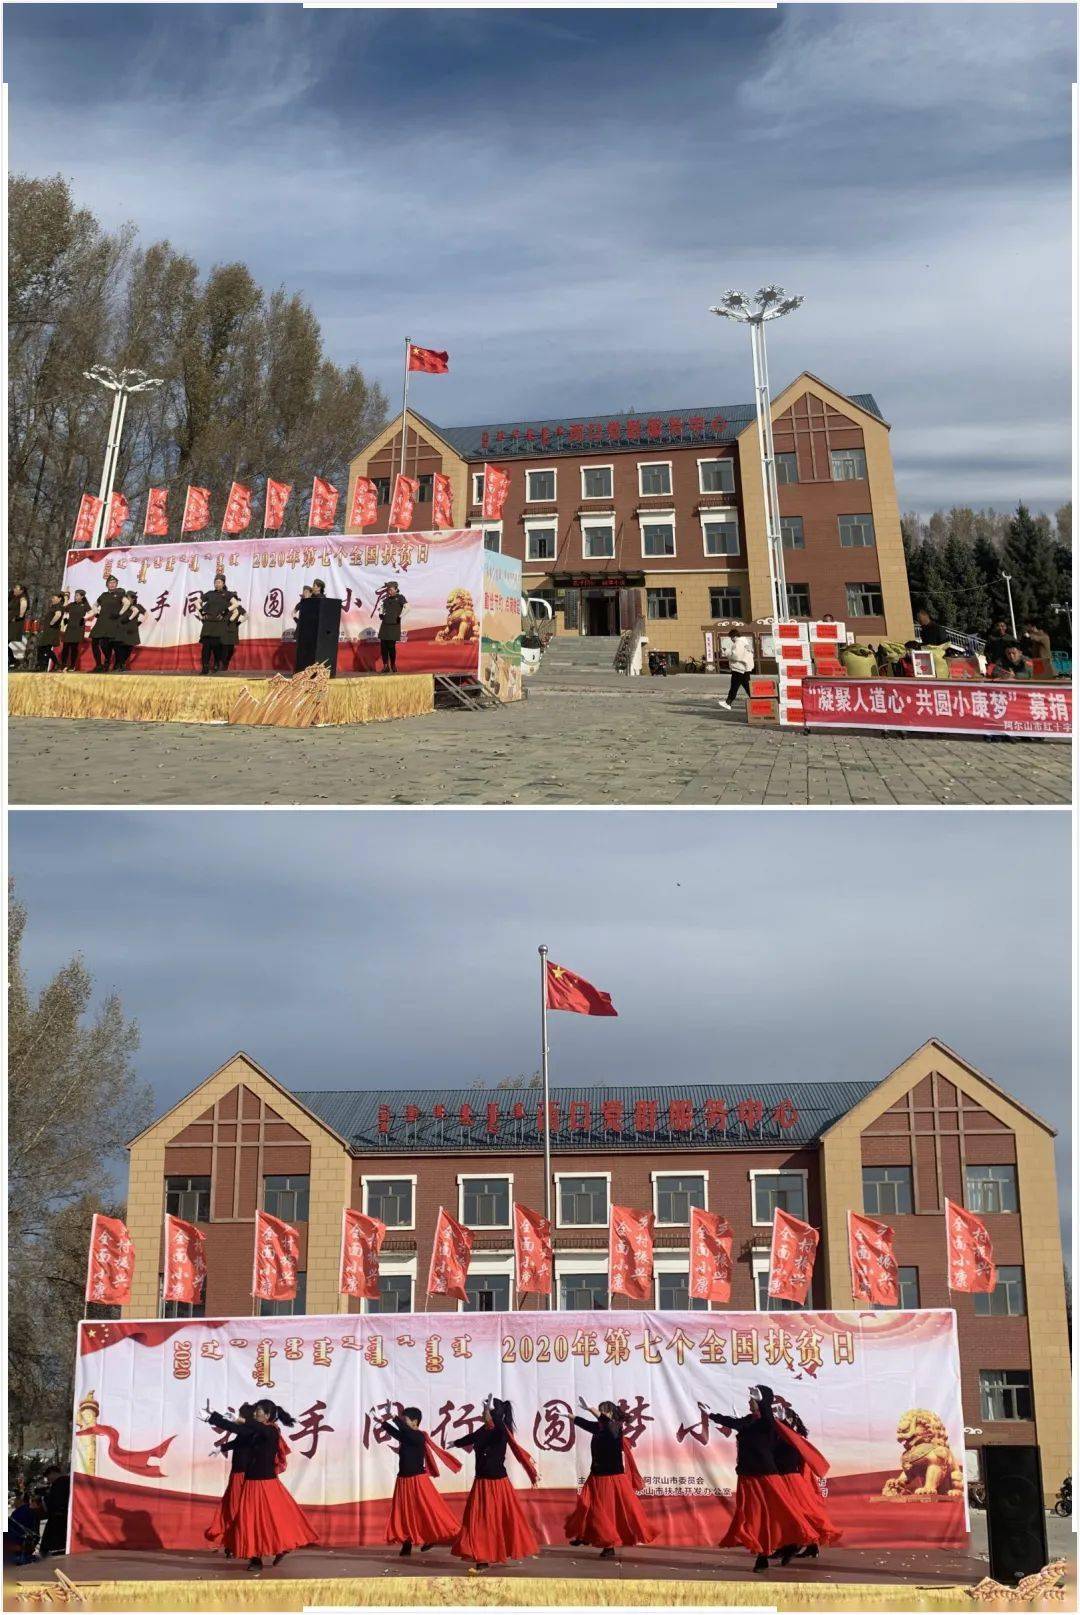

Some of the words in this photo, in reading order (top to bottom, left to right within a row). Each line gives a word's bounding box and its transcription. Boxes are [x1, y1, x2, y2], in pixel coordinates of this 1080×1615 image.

[252, 543, 429, 569] 2020年第七个全国扶贫日
[1028, 692, 1069, 721] 募捐
[501, 1327, 856, 1367] 2020年第七个全国扶贫日
[642, 1475, 705, 1486] 阿尔山市委员会
